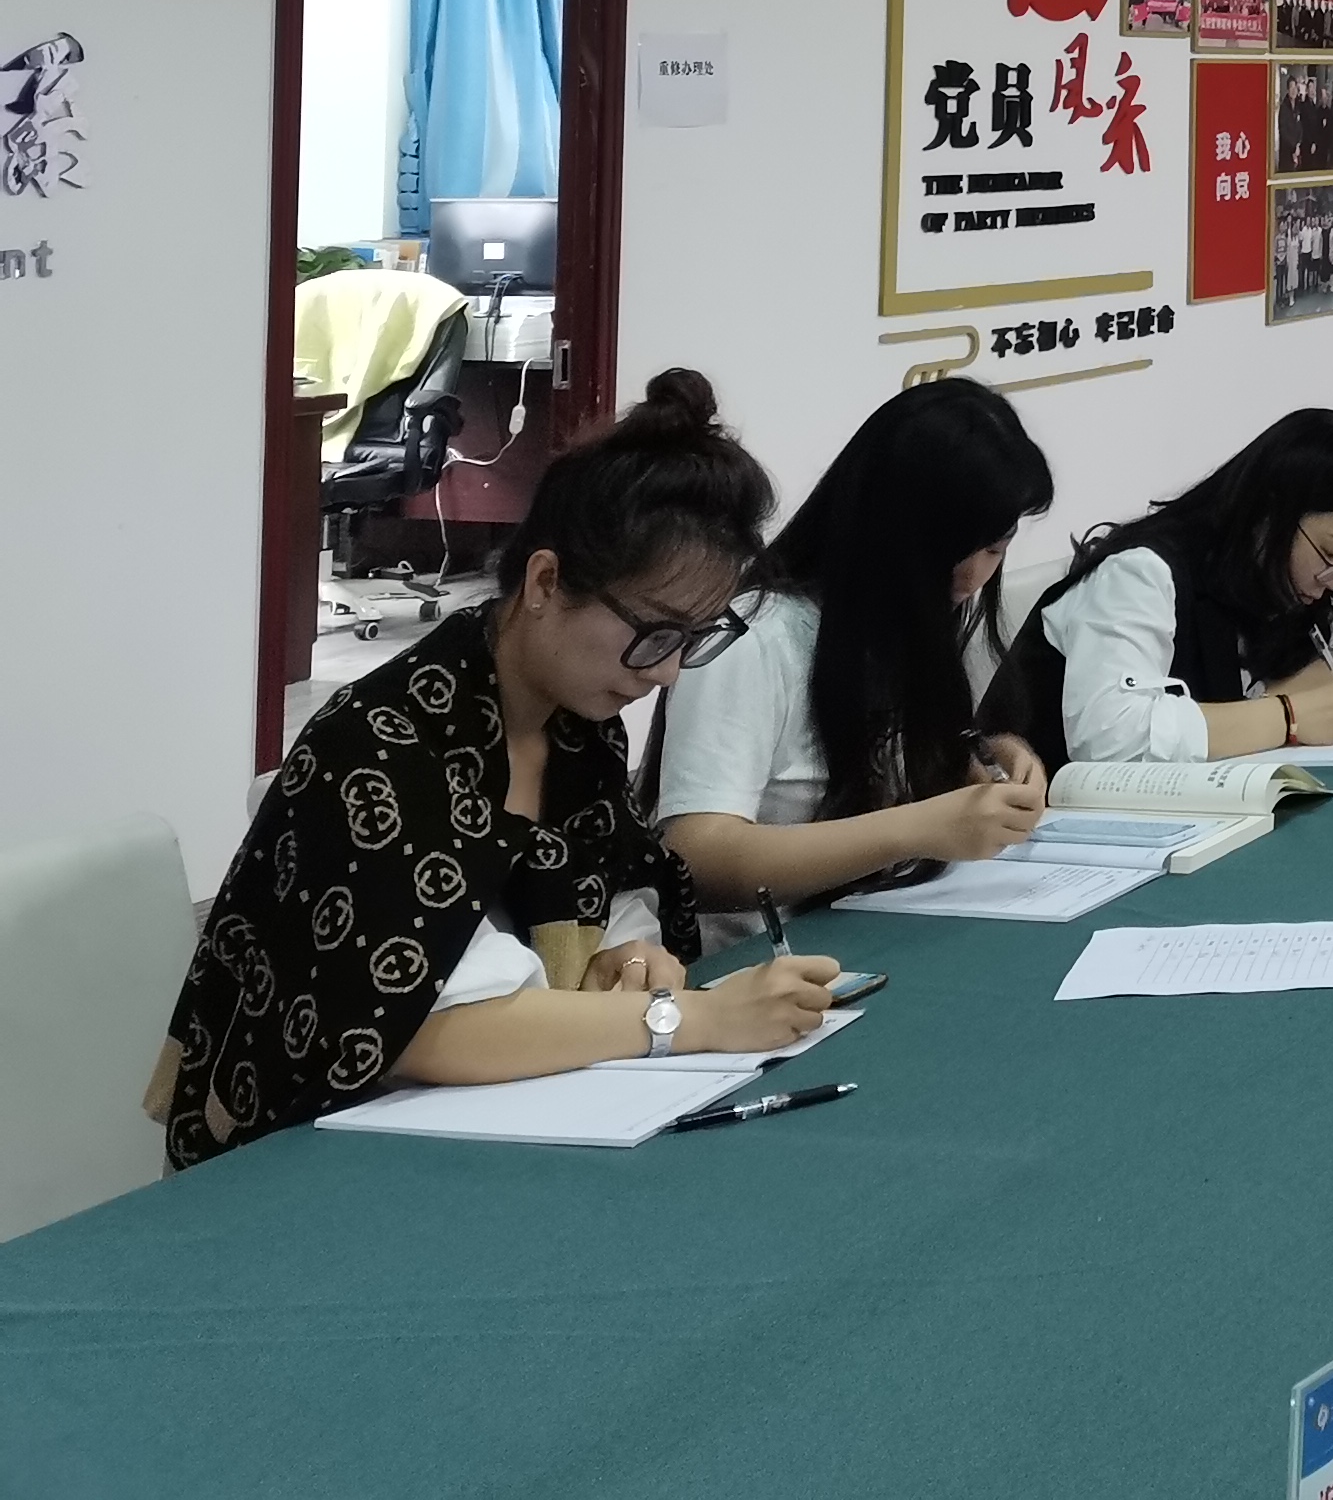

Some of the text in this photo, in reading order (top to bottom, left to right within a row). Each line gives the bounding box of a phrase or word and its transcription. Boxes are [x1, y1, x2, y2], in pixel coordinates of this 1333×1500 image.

[658, 60, 714, 76] 重修办理处
[923, 58, 1034, 152] 党员
[1215, 131, 1251, 161] 我心
[1215, 170, 1251, 201] 向党
